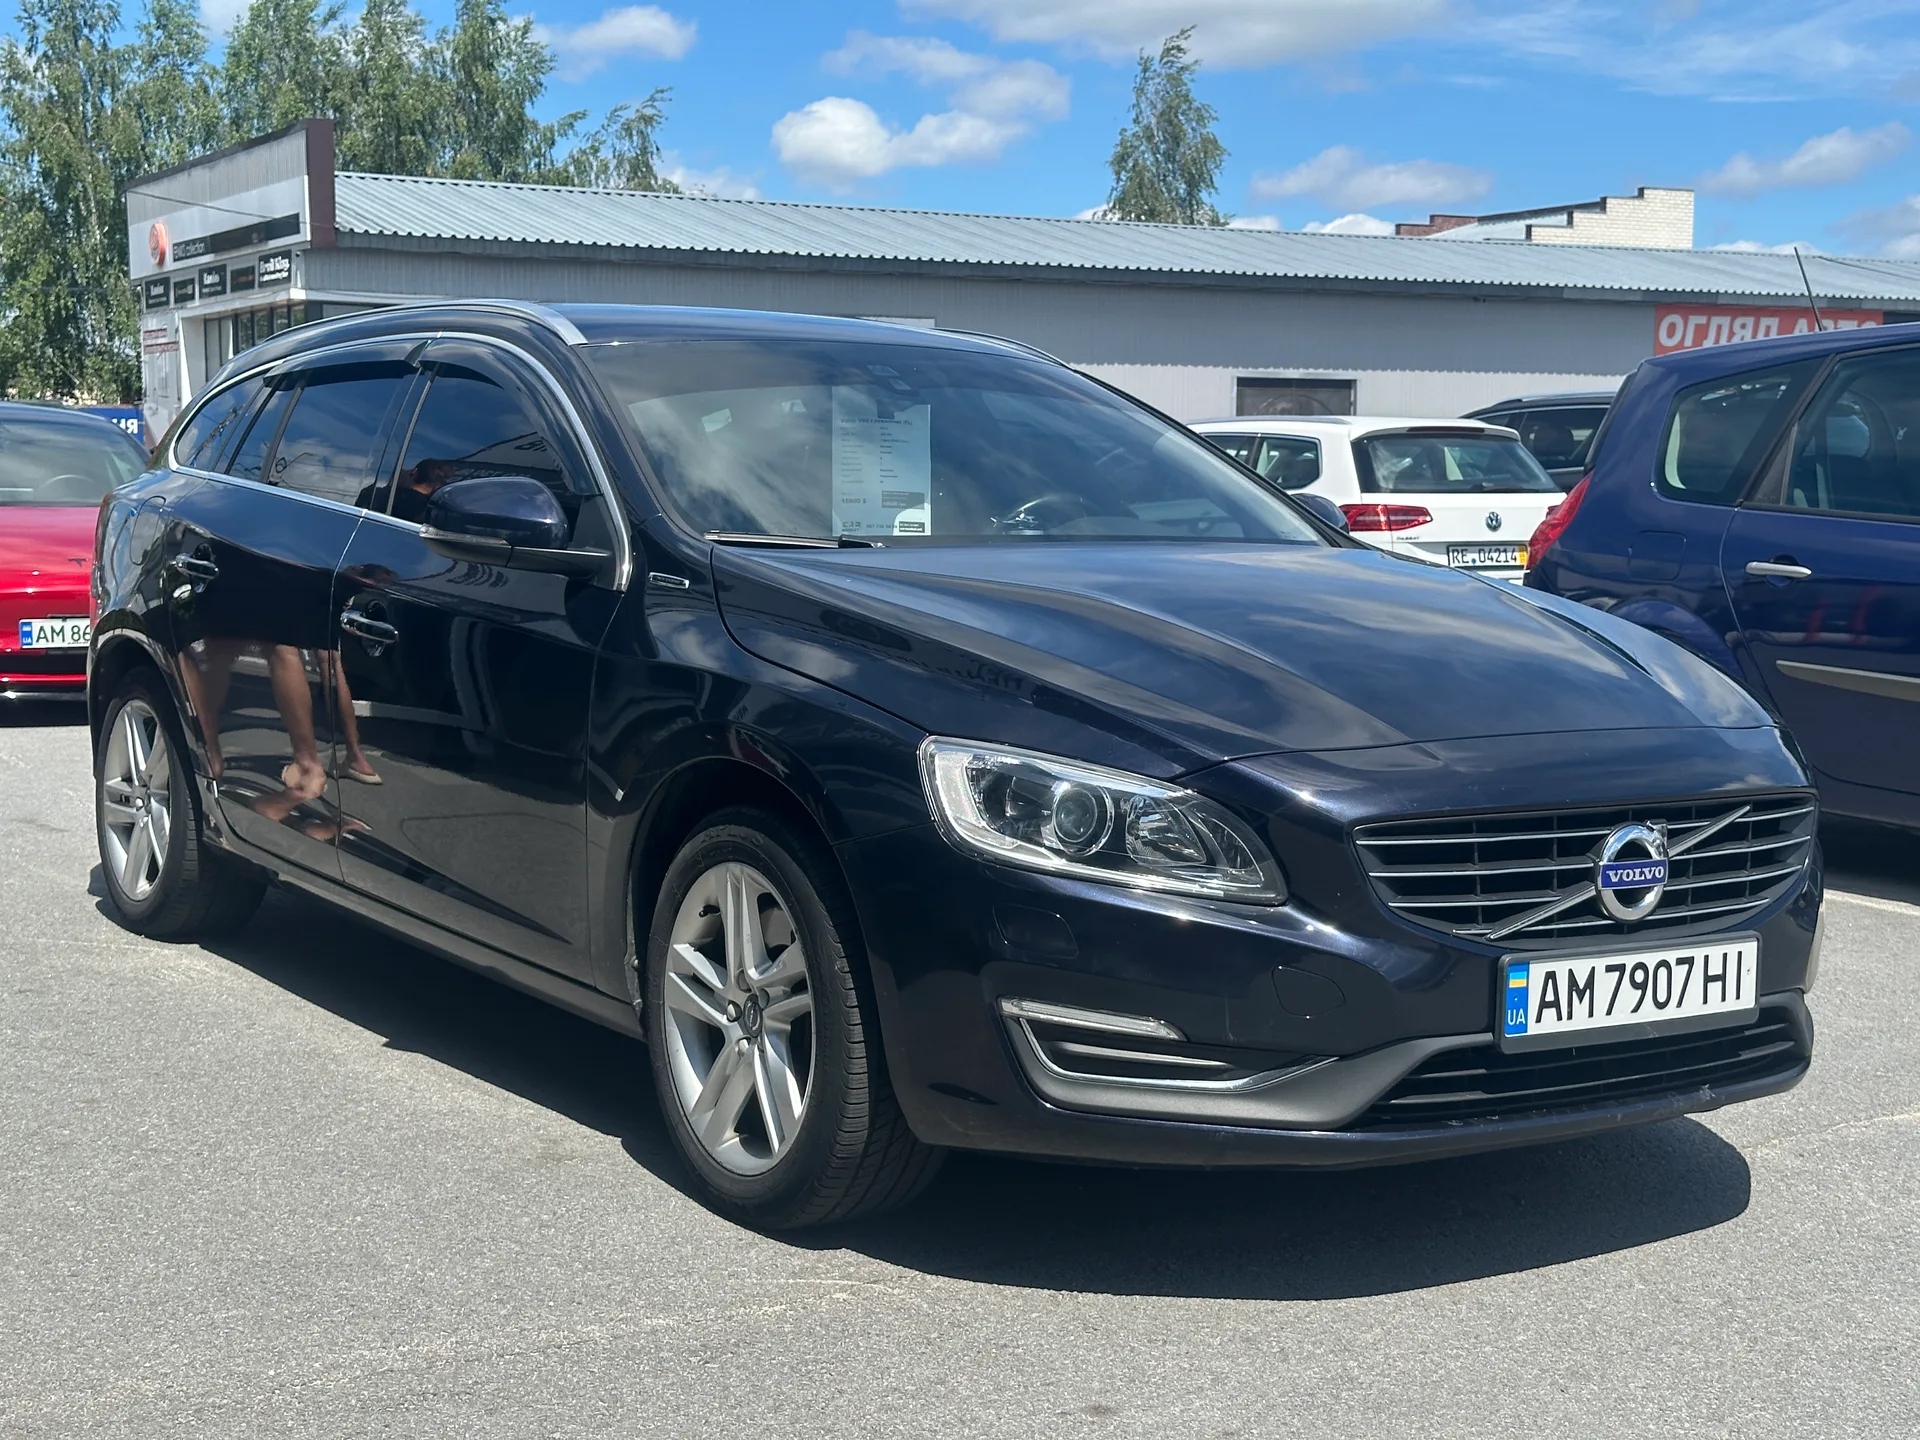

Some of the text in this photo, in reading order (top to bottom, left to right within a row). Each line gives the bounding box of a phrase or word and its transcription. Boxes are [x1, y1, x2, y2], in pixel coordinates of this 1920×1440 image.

[1452, 548, 1469, 564] RE
[1478, 547, 1517, 564] 04214
[1605, 864, 1665, 882] VOLVO
[1507, 1008, 1526, 1026] UA
